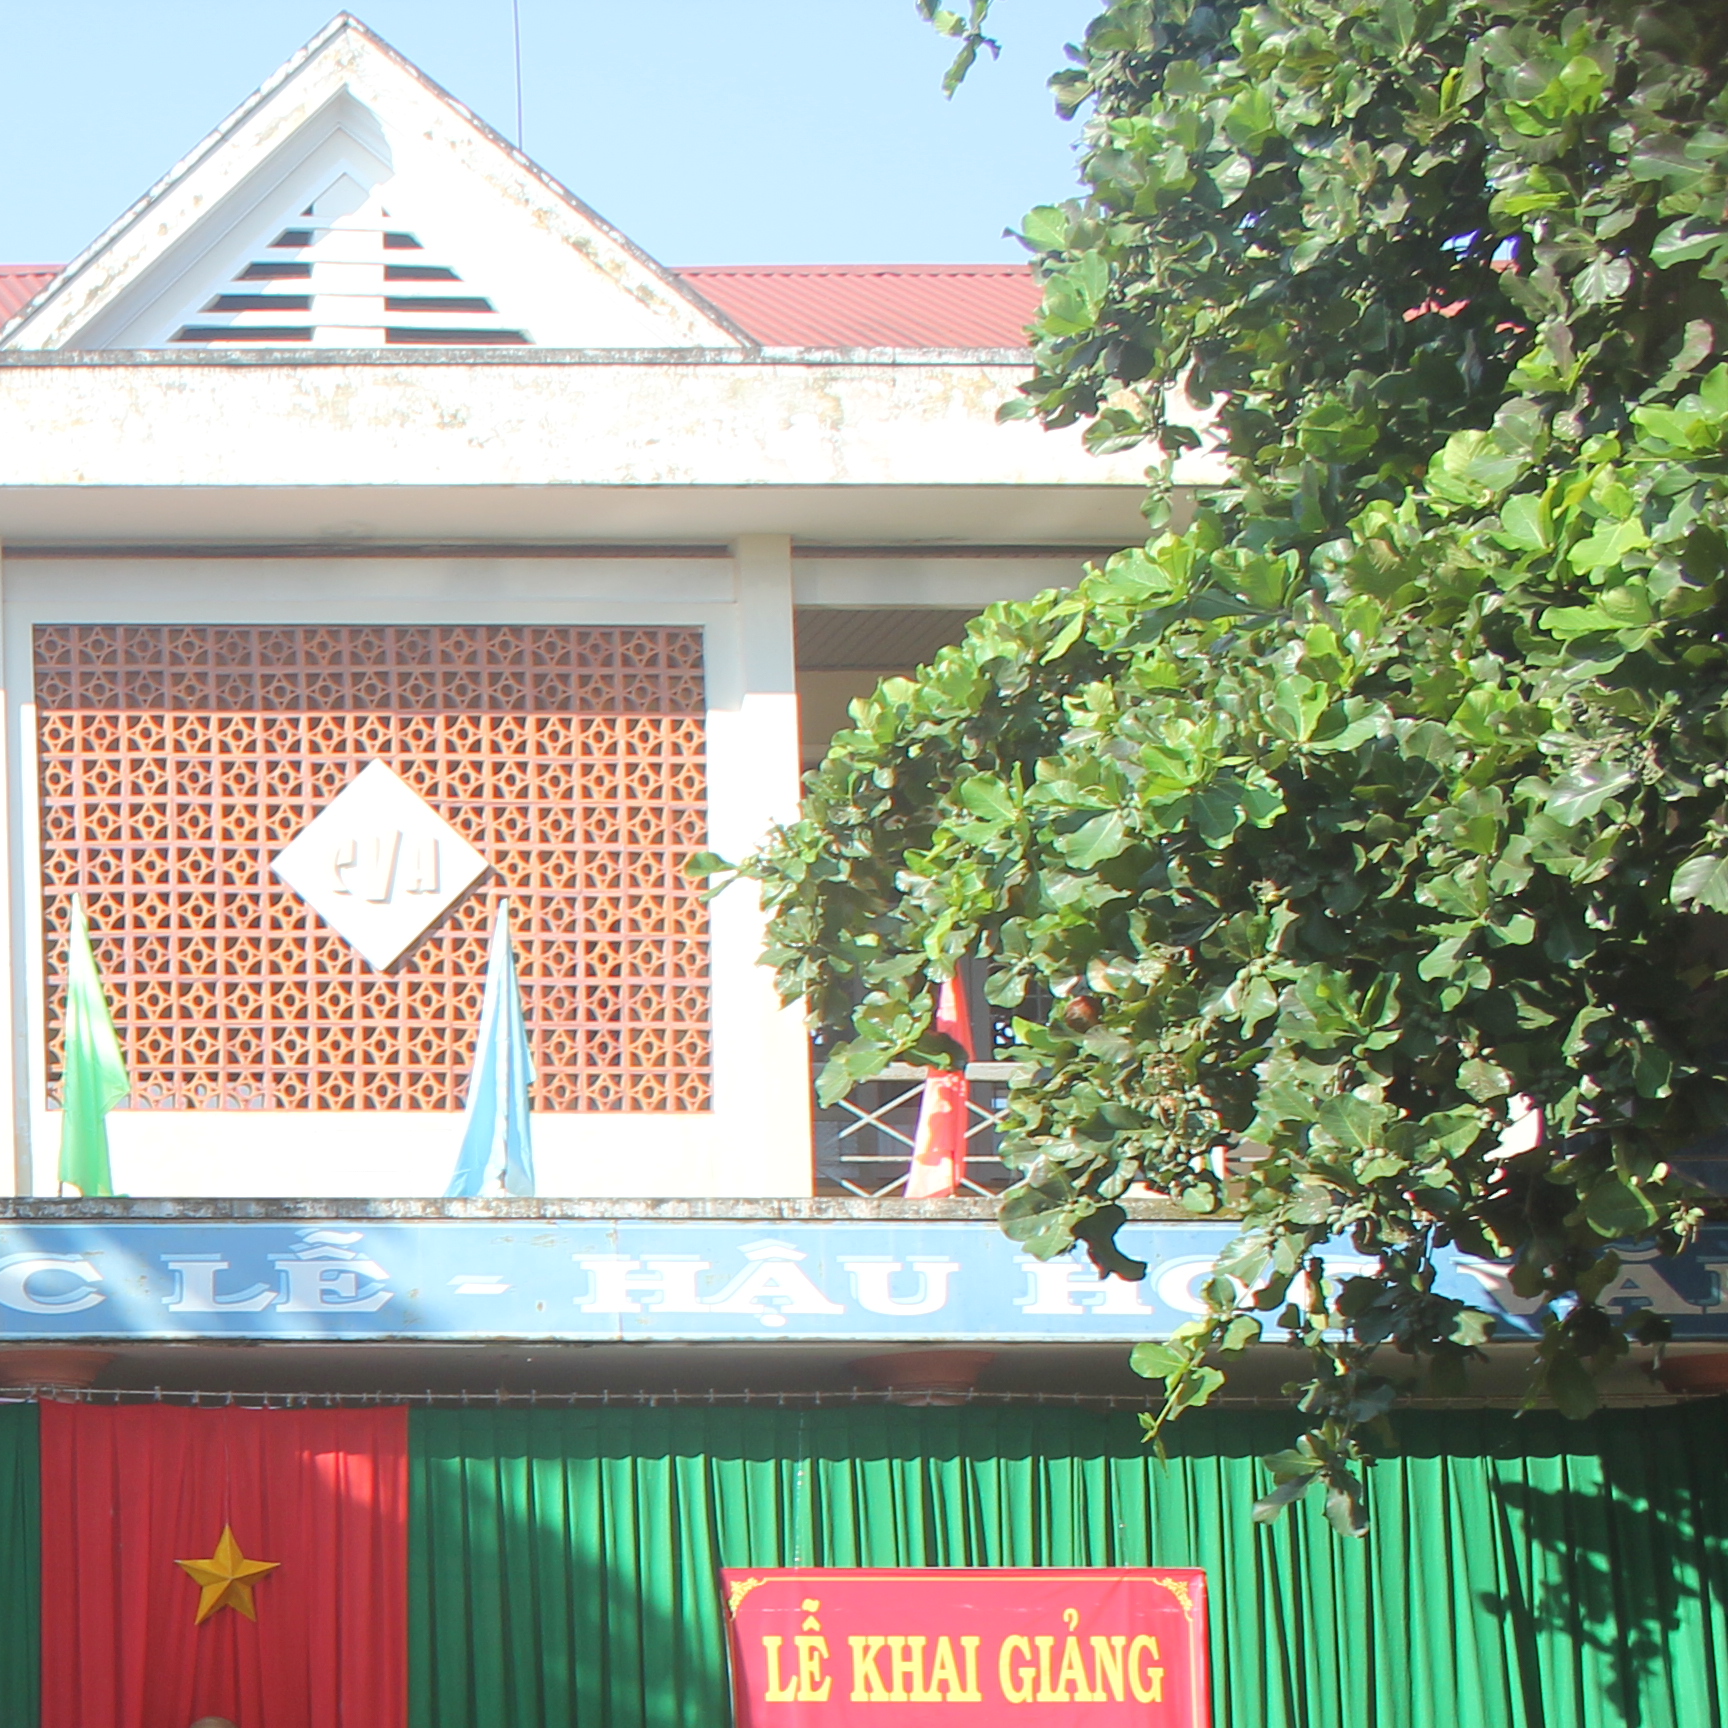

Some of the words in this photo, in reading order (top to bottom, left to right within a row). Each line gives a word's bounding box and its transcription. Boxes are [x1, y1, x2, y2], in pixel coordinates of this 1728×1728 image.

[162, 1228, 394, 1313] LỄ
[574, 1238, 959, 1327] HẬU
[1449, 1242, 1728, 1315] VĂ
[762, 1598, 832, 1702] LỄ
[847, 1635, 982, 1702] KHAI
[998, 1607, 1164, 1703] GIẢNG
